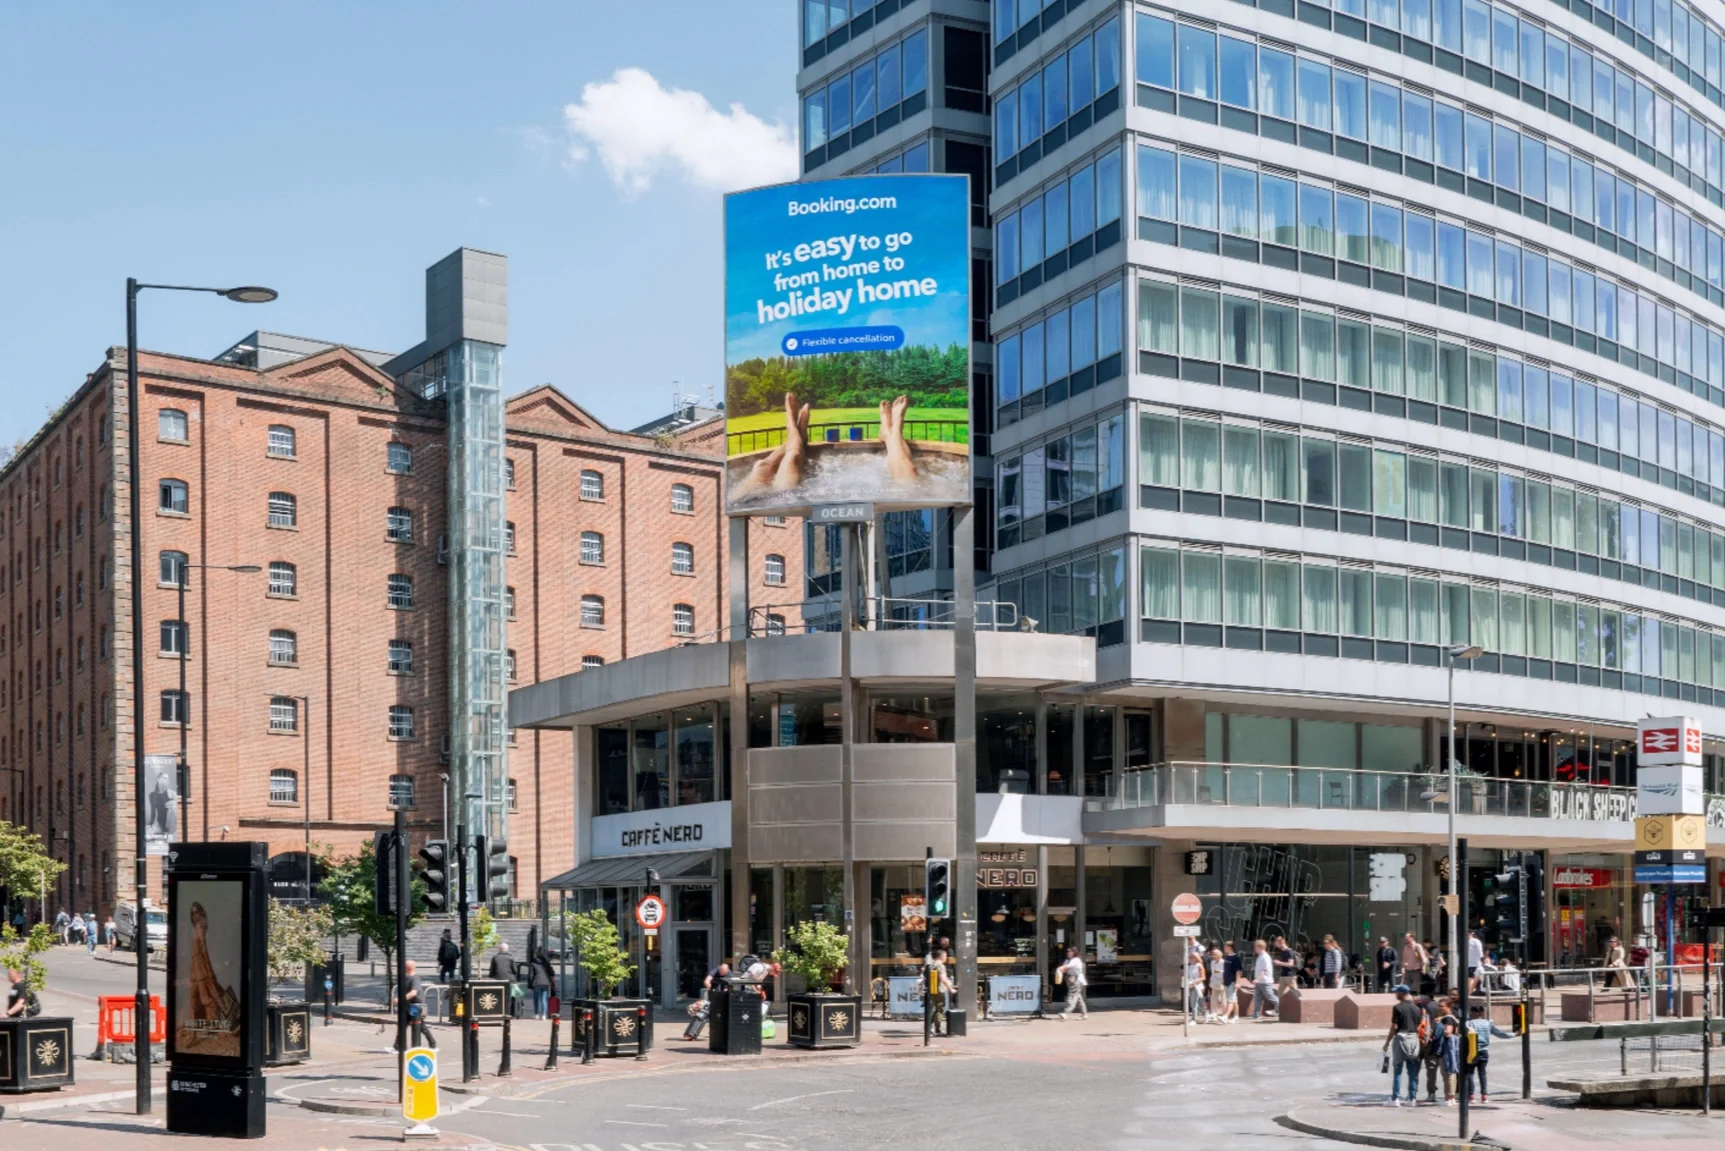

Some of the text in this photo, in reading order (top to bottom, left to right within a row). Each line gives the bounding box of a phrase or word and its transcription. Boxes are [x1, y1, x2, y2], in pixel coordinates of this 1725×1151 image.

[788, 196, 897, 216] Booking.com
[766, 231, 913, 270] It's easy to go
[774, 256, 905, 292] from home to
[757, 276, 938, 324] holiday home
[802, 334, 895, 347] Flexible cancellation
[821, 507, 864, 518] OCEAN
[1552, 790, 1590, 820] BLACK
[1593, 792, 1627, 821] SHEEP
[663, 824, 703, 842] NERO
[998, 990, 1034, 1001] NERO
